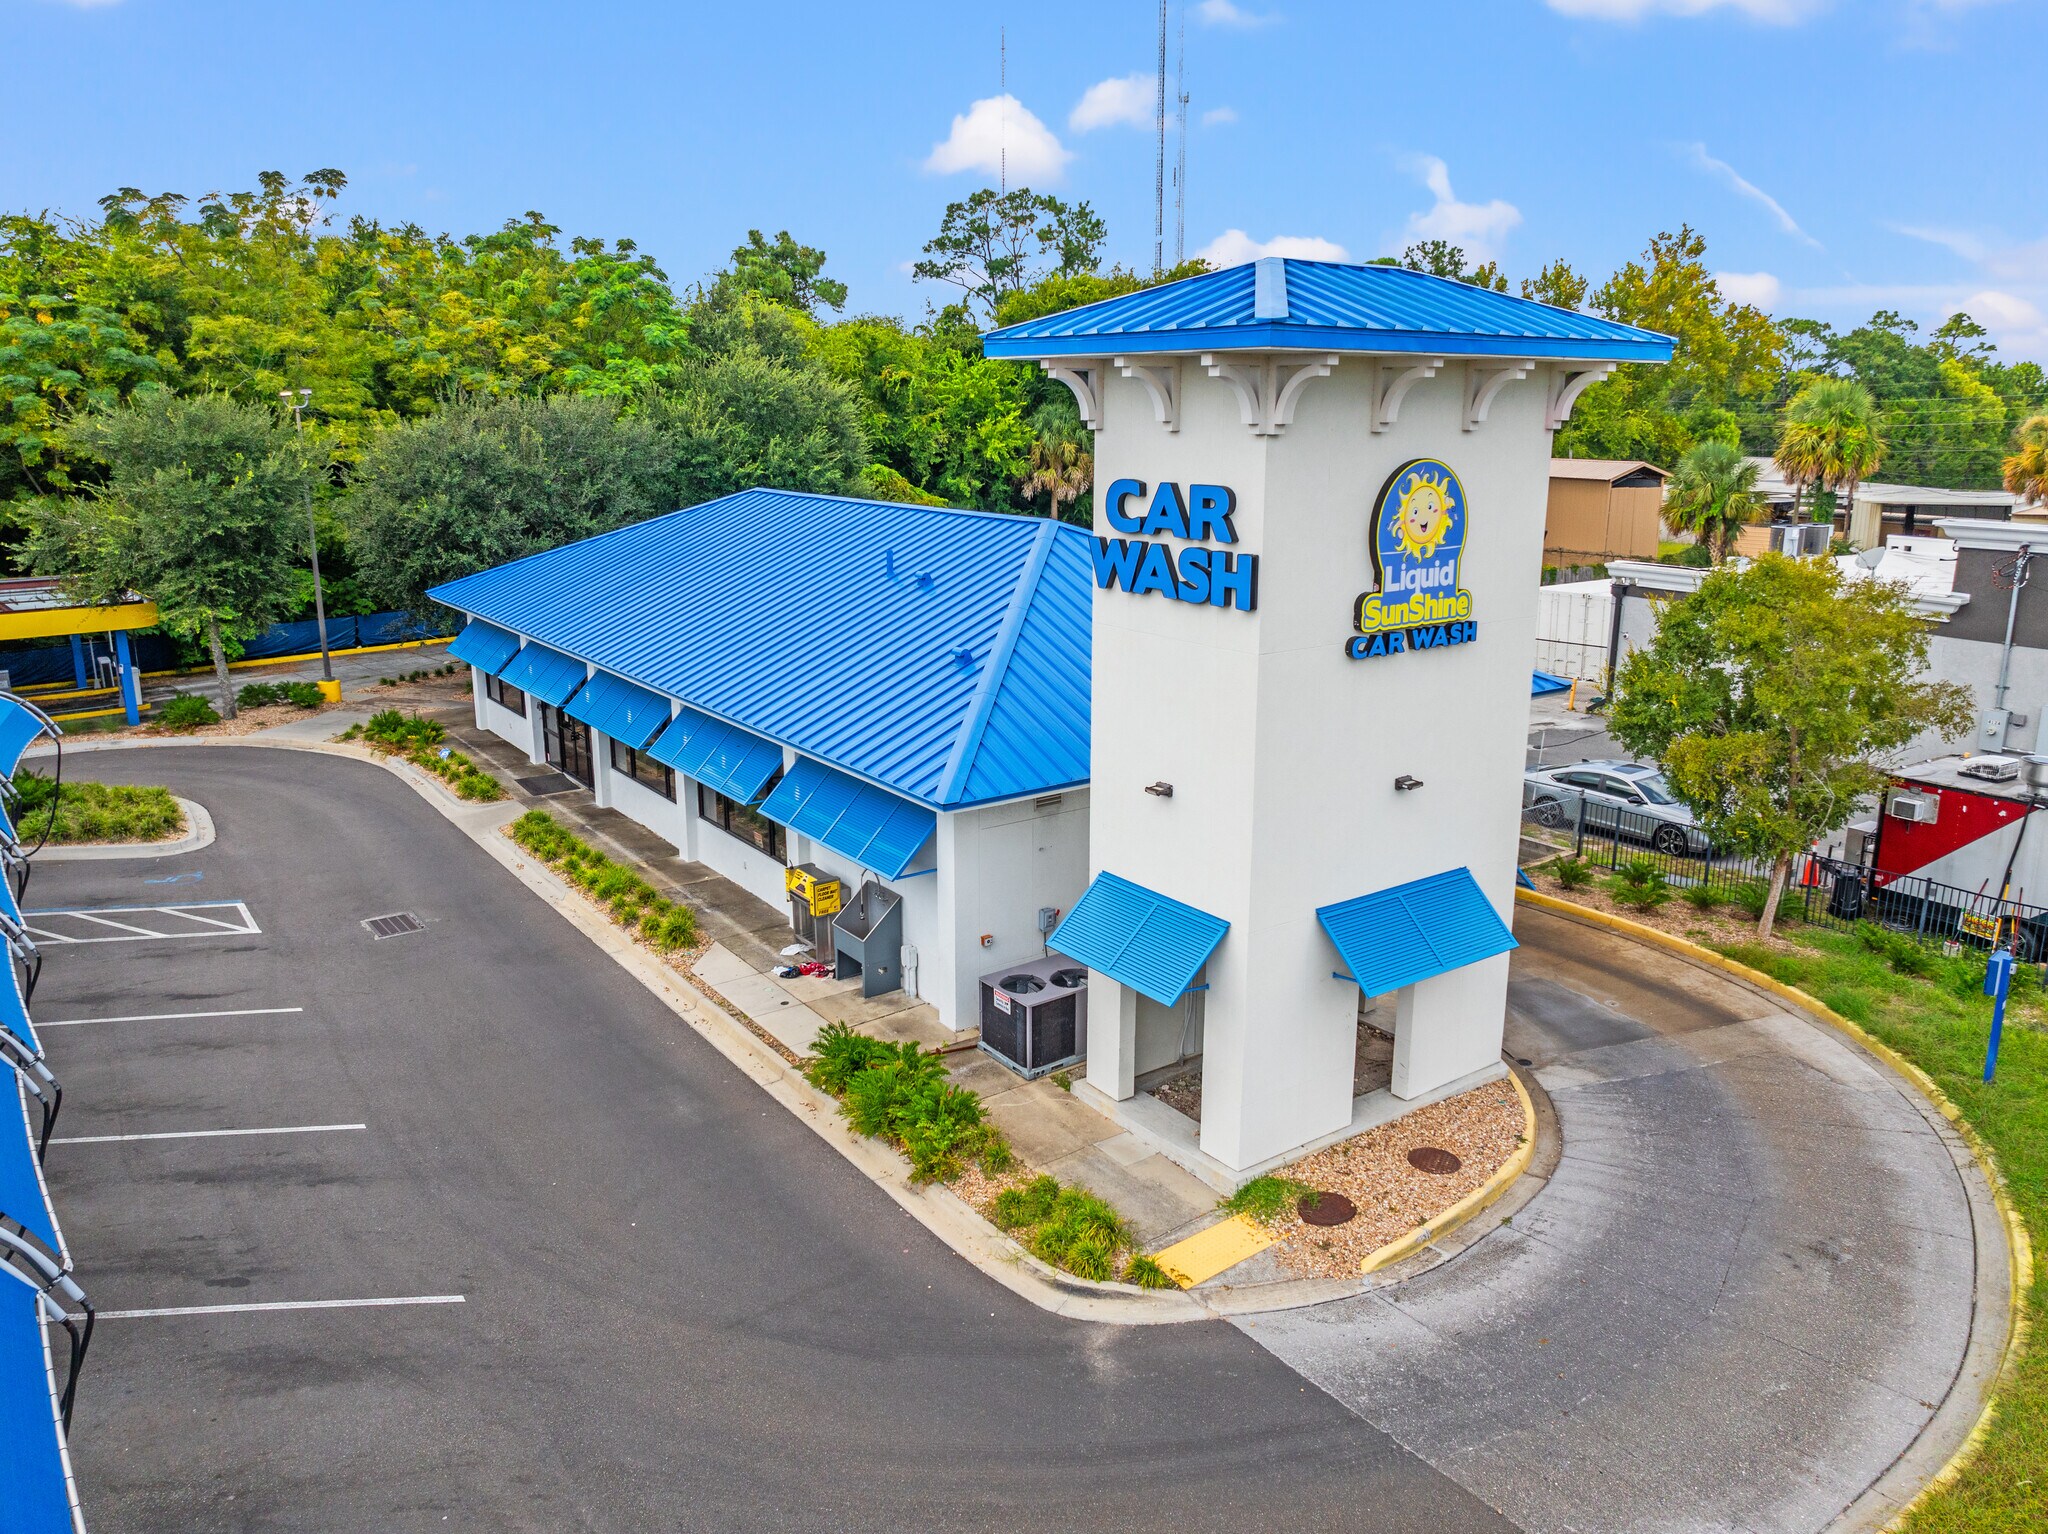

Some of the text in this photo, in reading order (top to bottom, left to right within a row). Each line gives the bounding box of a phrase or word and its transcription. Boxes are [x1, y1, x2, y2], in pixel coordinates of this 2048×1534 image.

[1105, 478, 1238, 544] CAR
[1088, 535, 1258, 612] WASH
[1384, 559, 1455, 598] Liquid
[1364, 591, 1469, 629] SunShine
[1347, 621, 1478, 660] CAR WASH
